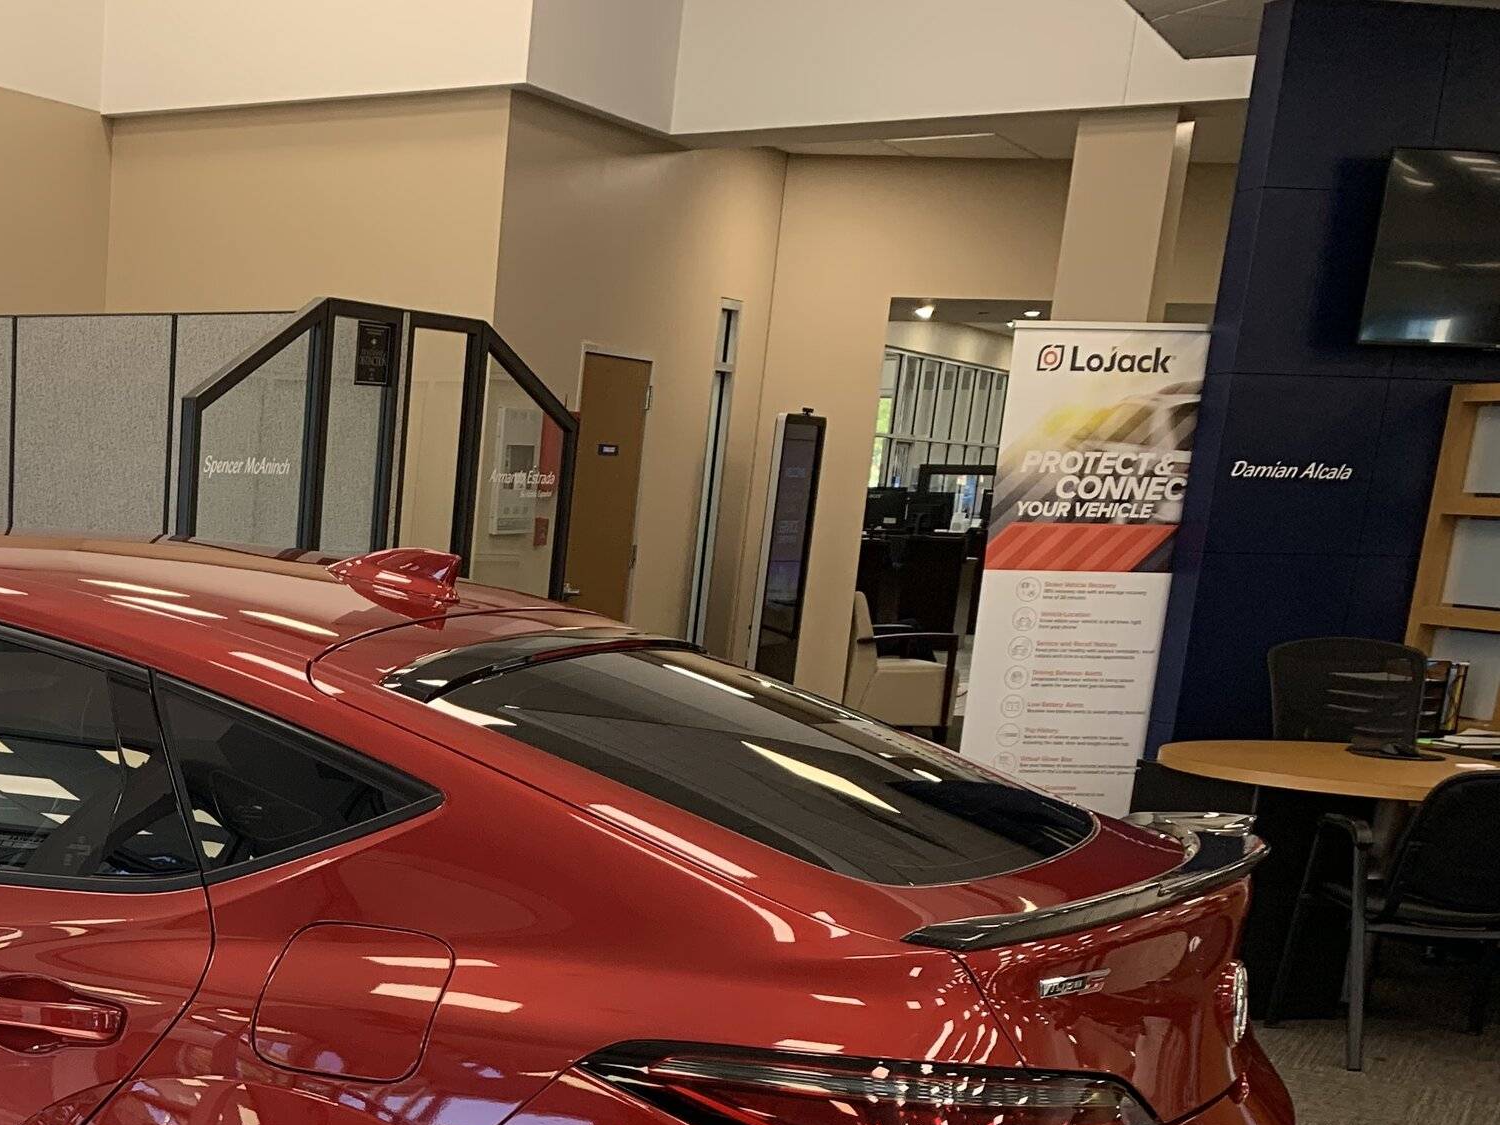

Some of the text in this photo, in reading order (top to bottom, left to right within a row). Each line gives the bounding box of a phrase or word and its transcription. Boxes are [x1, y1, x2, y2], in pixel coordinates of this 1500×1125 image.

[203, 455, 244, 478] Spencer
[1020, 450, 1175, 475] PROTECT &
[1231, 460, 1353, 480] Damian Alcala
[1056, 475, 1188, 501] CONNEC
[1017, 501, 1154, 519] YOUR VEHICLE
